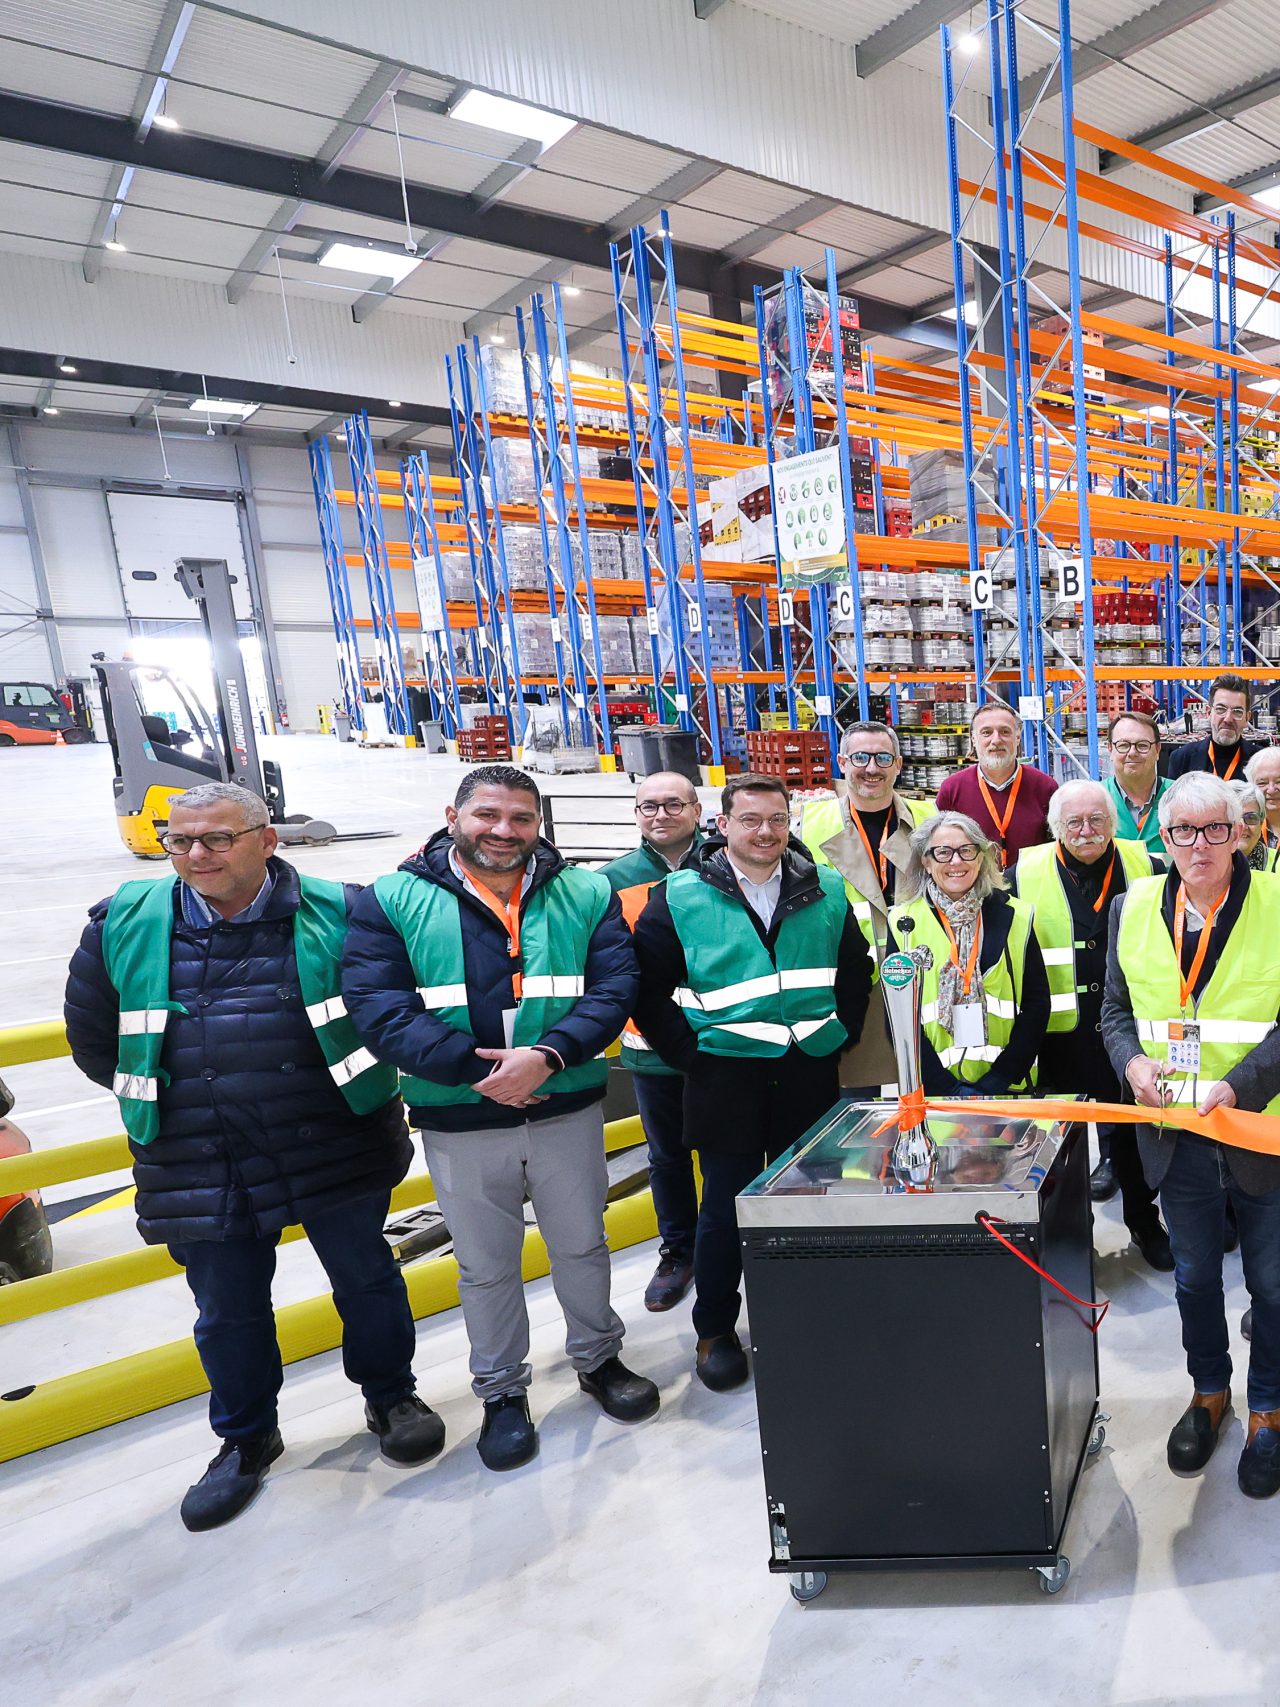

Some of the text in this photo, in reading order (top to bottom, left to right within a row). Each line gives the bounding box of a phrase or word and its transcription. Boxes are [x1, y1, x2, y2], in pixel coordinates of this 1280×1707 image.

[974, 575, 989, 604] C
[1063, 565, 1080, 596] B
[781, 597, 791, 621] D
[840, 590, 851, 616] C
[583, 618, 591, 636] E
[650, 611, 656, 631] E
[690, 607, 699, 628] D
[226, 684, 247, 753] JUNGHEINRICH
